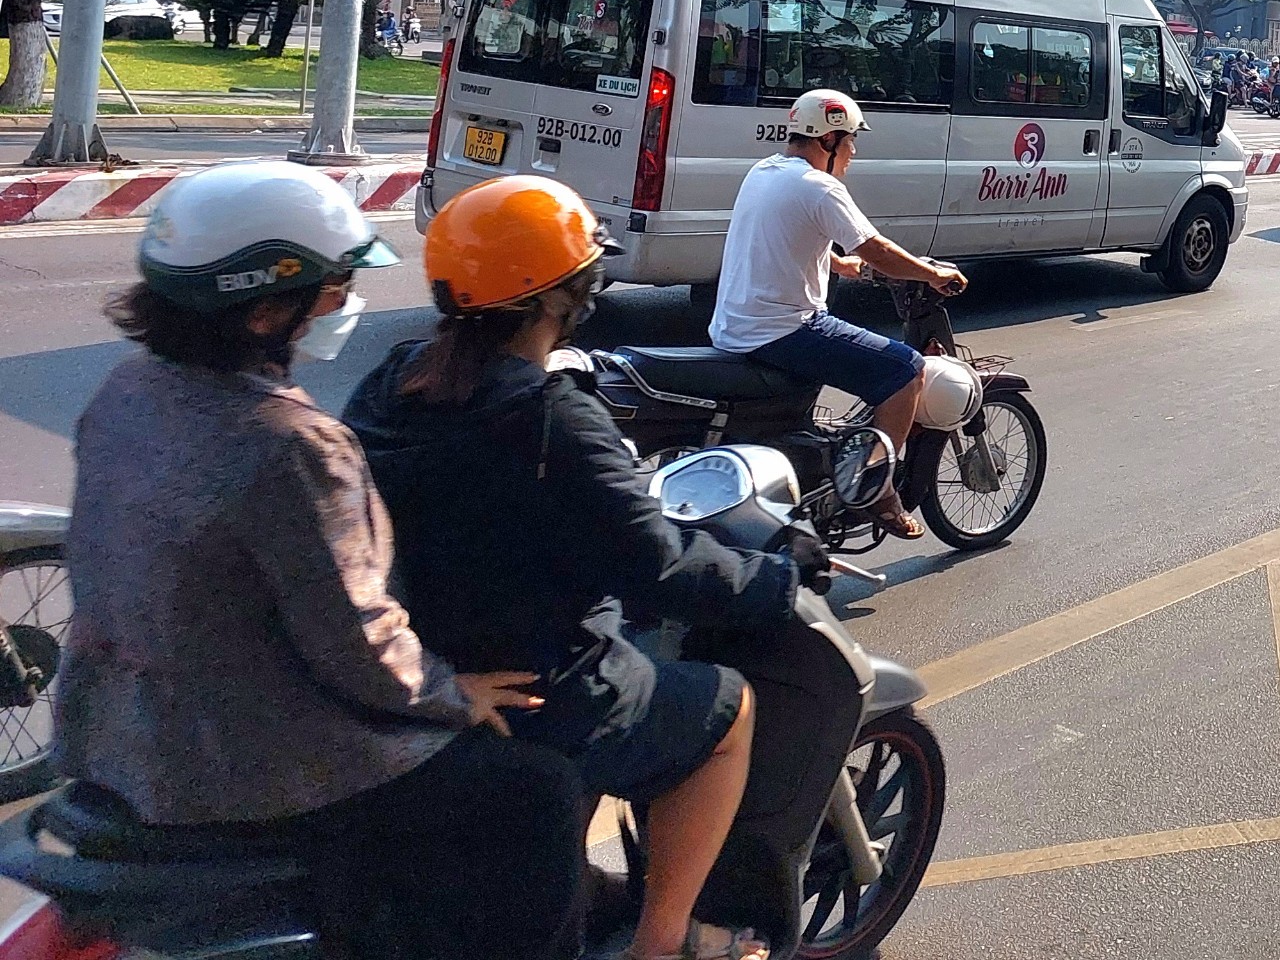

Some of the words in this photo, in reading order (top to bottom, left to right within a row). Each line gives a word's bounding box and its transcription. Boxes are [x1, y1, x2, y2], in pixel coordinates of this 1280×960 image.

[598, 78, 608, 89] XE
[609, 80, 620, 90] DU
[477, 131, 494, 145] 92B
[537, 117, 622, 147] 92B-012.00
[756, 124, 789, 141] 92B
[468, 145, 497, 161] 012.00
[978, 166, 1031, 201] Barri
[1026, 167, 1069, 203] Ann
